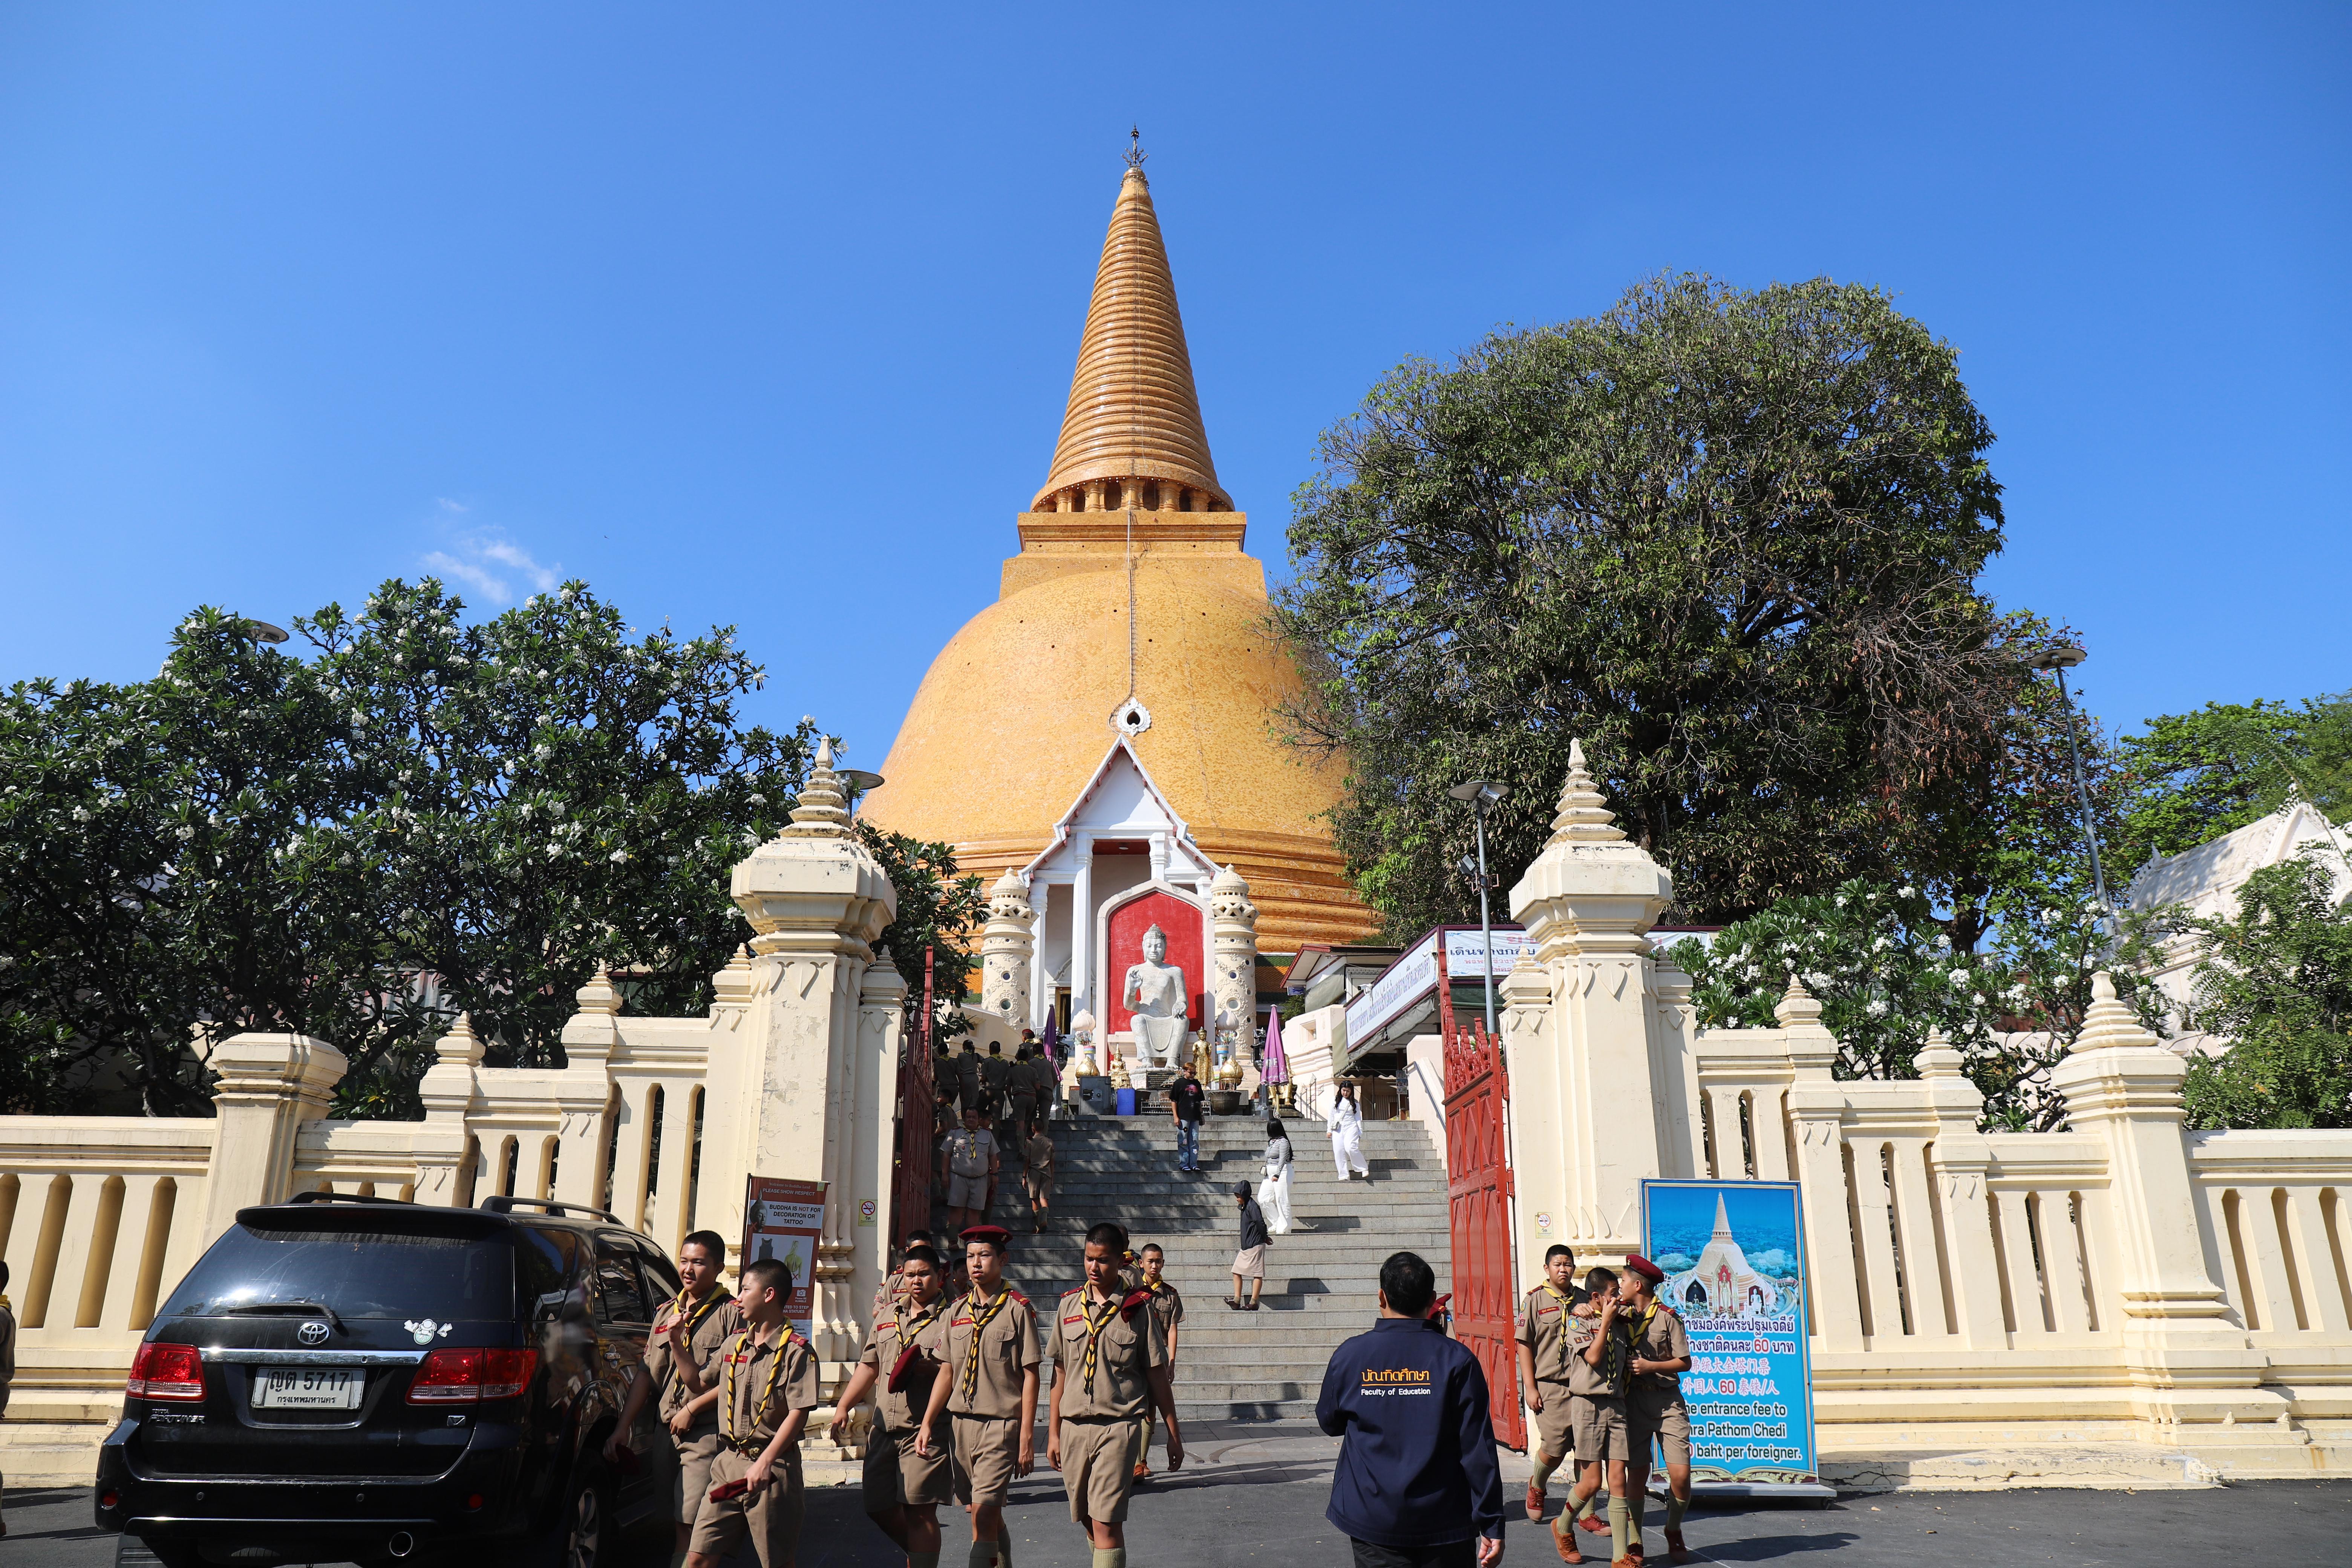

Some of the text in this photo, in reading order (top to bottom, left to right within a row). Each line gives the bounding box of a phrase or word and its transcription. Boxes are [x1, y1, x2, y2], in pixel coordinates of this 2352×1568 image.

[1754, 1339, 1769, 1352] 60
[1772, 1341, 1794, 1352] บาท
[1361, 1368, 1429, 1381] บัณฑิตศึกษา
[303, 1372, 349, 1391] 5717
[1683, 1378, 1717, 1394] 外国人
[1720, 1380, 1735, 1393] 60
[1361, 1389, 1385, 1397] Faculty
[277, 1395, 336, 1405] กรุงเทพมหานคร
[1701, 1403, 1750, 1415] entrance
[1753, 1403, 1771, 1415] fee
[1774, 1403, 1786, 1416] to
[147, 1414, 205, 1424] FORTUNER
[1708, 1423, 1750, 1436] Pathom
[1754, 1423, 1785, 1437] Chedi
[1697, 1444, 1723, 1457] baht
[1726, 1447, 1744, 1461] per
[1747, 1445, 1801, 1462] foreigner.
